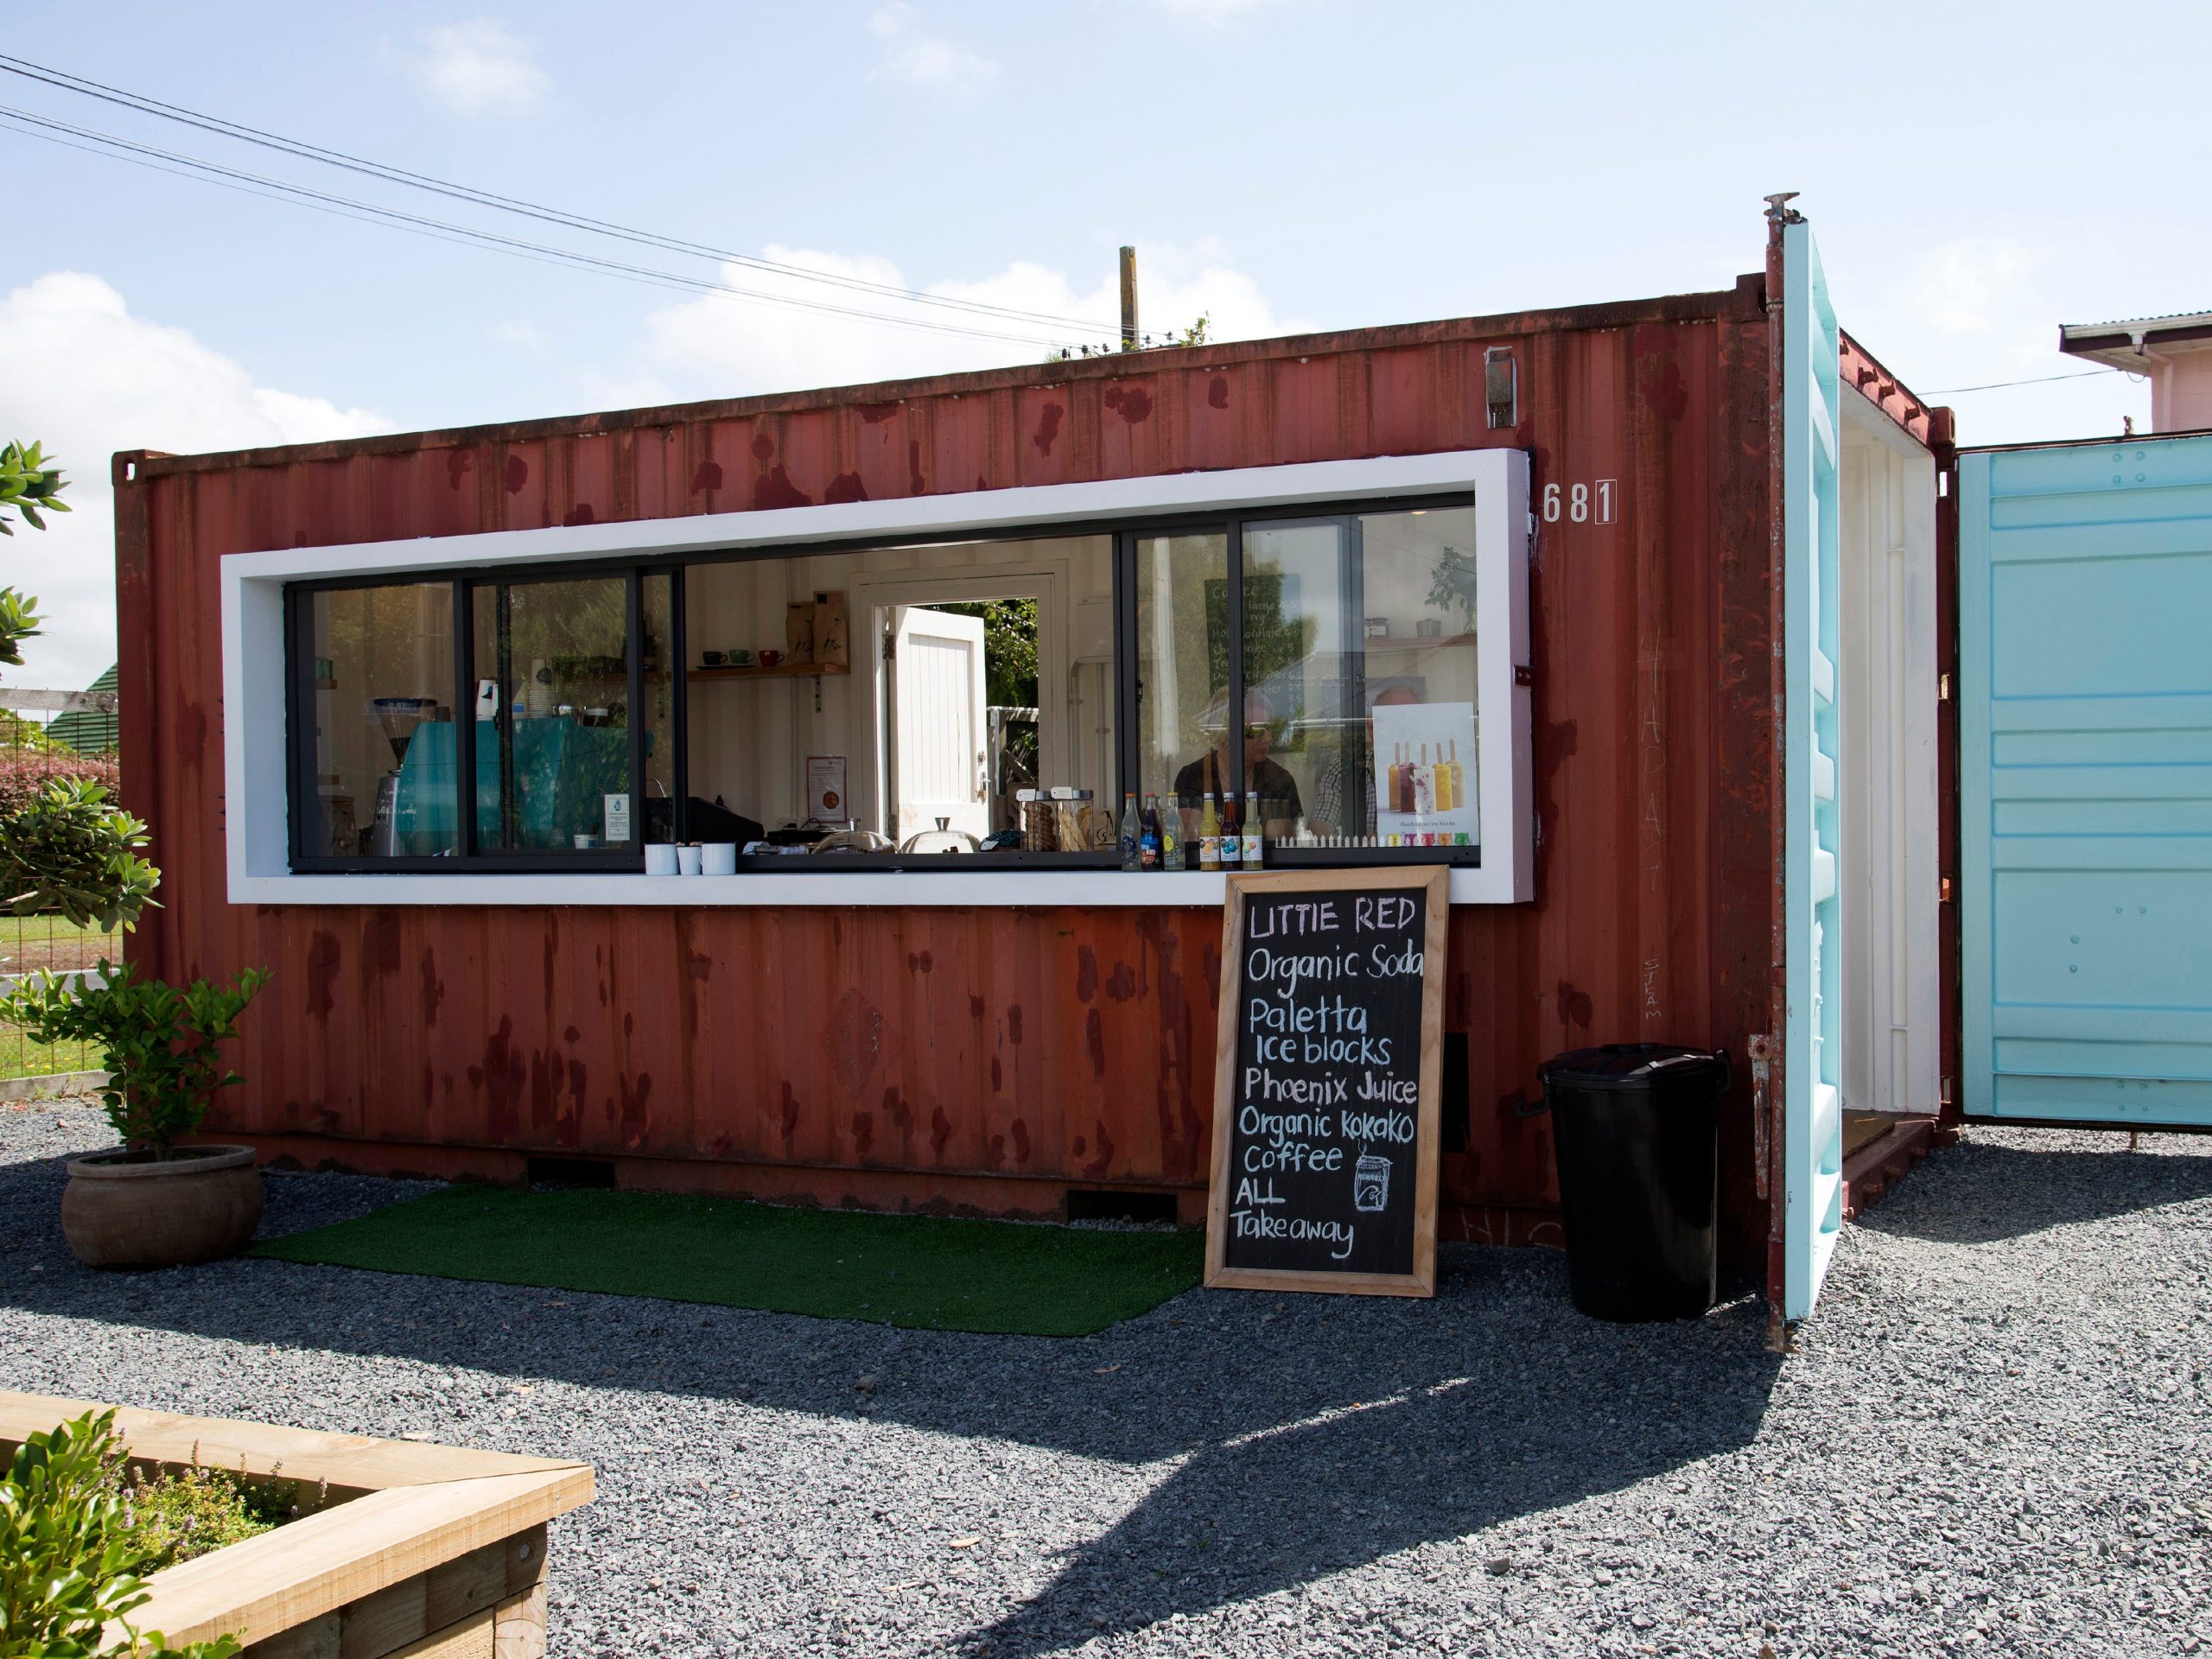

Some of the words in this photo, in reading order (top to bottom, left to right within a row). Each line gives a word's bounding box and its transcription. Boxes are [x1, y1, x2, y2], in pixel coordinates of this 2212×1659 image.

[1356, 898, 1414, 933] RED
[1249, 945, 1359, 999] Organic
[1367, 938, 1424, 978] Soda
[1250, 994, 1366, 1034] Paletta
[1257, 1035, 1296, 1064] Ice
[1305, 1034, 1391, 1065] blocks
[1246, 1067, 1347, 1105] Phoenix
[1357, 1071, 1416, 1103] Juice
[1239, 1105, 1332, 1147] Organic
[1244, 1141, 1343, 1172] Coffee
[1236, 1177, 1285, 1205] ALL
